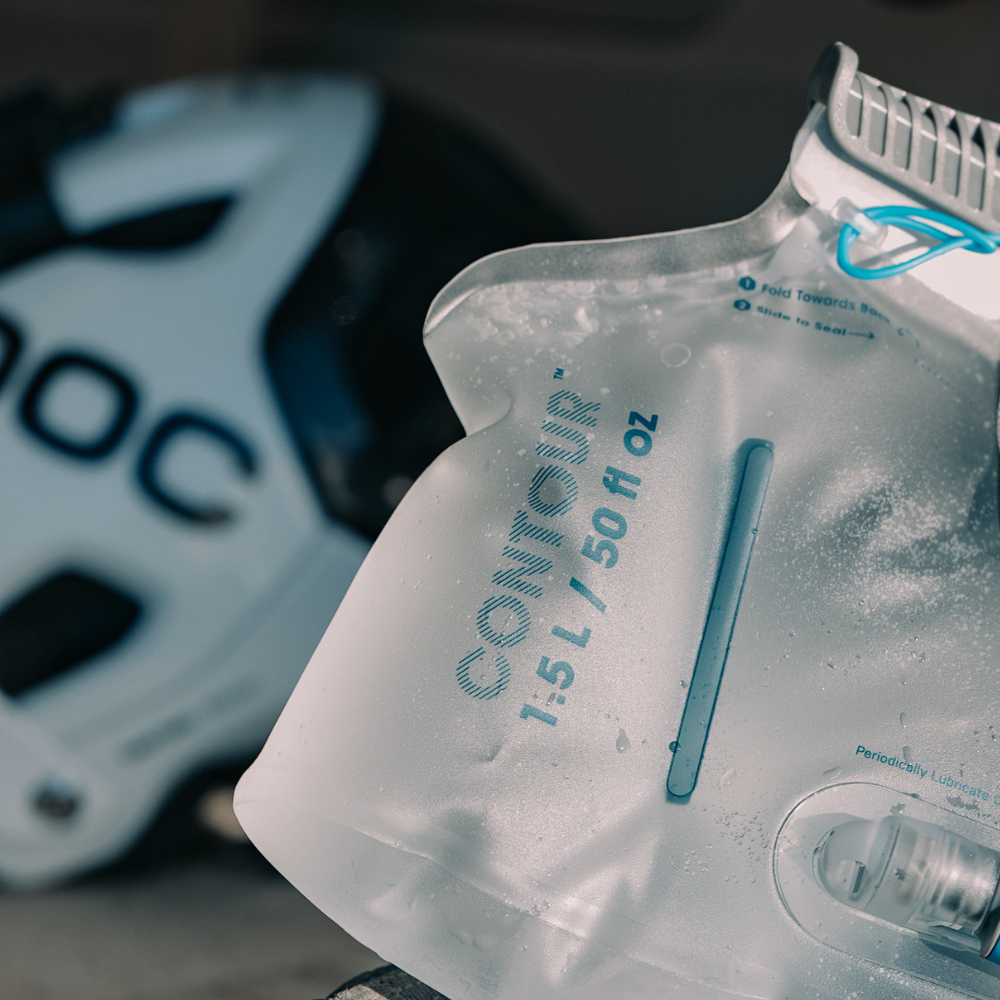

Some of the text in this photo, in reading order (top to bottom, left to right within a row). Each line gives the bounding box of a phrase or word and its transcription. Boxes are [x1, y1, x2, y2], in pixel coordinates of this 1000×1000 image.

[761, 284, 791, 299] Fold
[797, 290, 855, 311] Towards
[757, 305, 791, 321] Slide
[796, 317, 810, 327] to
[814, 321, 847, 336] Seal
[0, 313, 260, 526] OC
[624, 411, 659, 457] oz
[603, 465, 641, 500] fl
[581, 507, 628, 569] 50
[551, 625, 592, 648] L
[855, 745, 928, 778] Periodically
[931, 771, 989, 801] Lubricate
